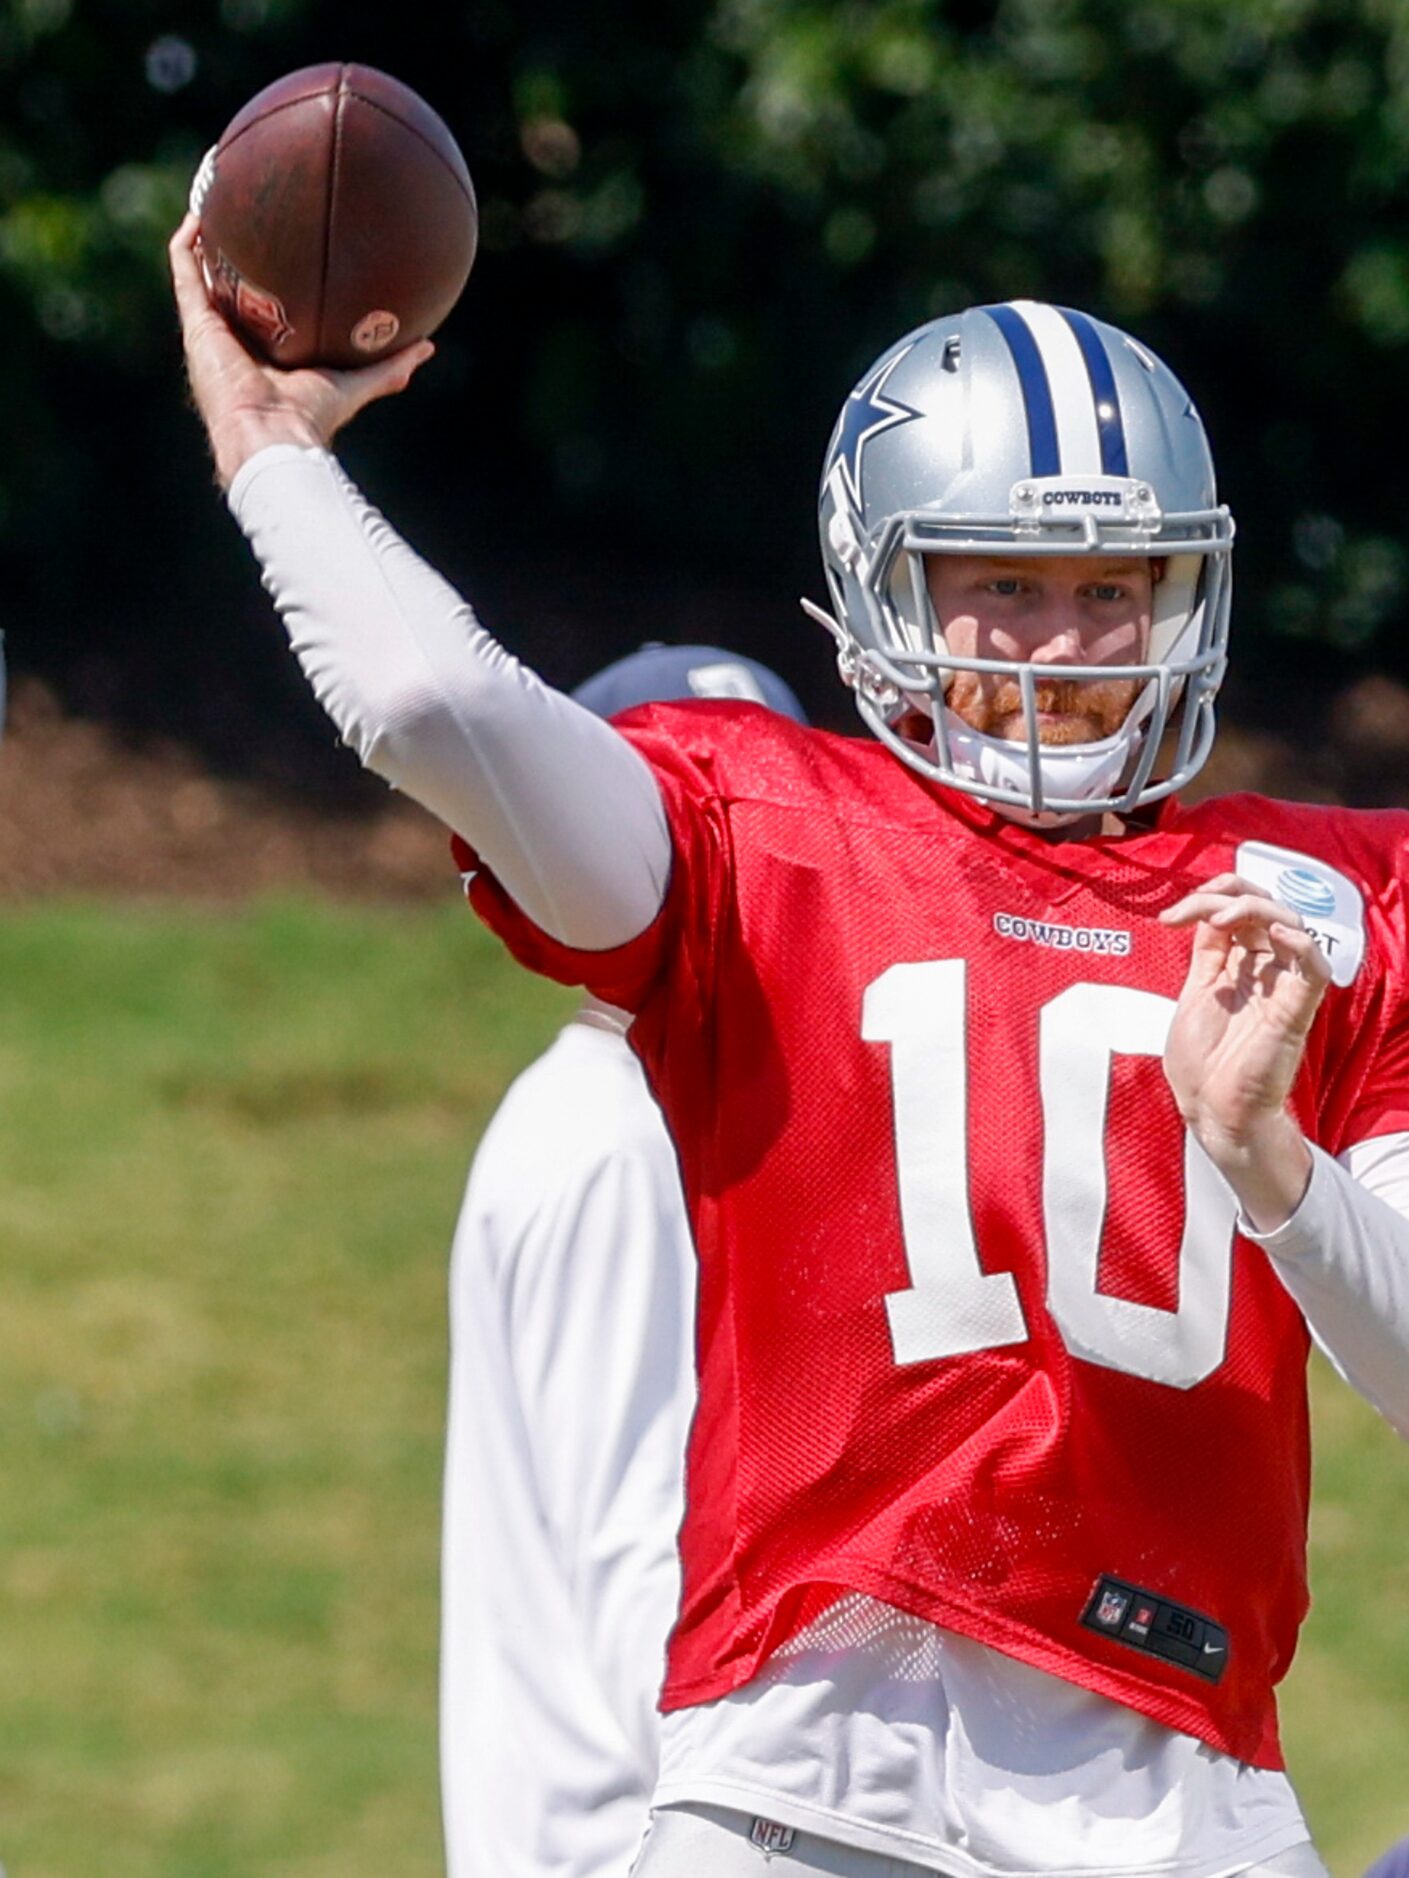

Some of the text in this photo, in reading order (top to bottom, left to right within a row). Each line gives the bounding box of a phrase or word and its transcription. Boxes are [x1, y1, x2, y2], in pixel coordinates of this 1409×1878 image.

[1042, 491, 1122, 507] COWBOYS
[994, 913, 1130, 954] COWBOYS
[860, 957, 1239, 1391] 10
[754, 1819, 791, 1848] NFL
